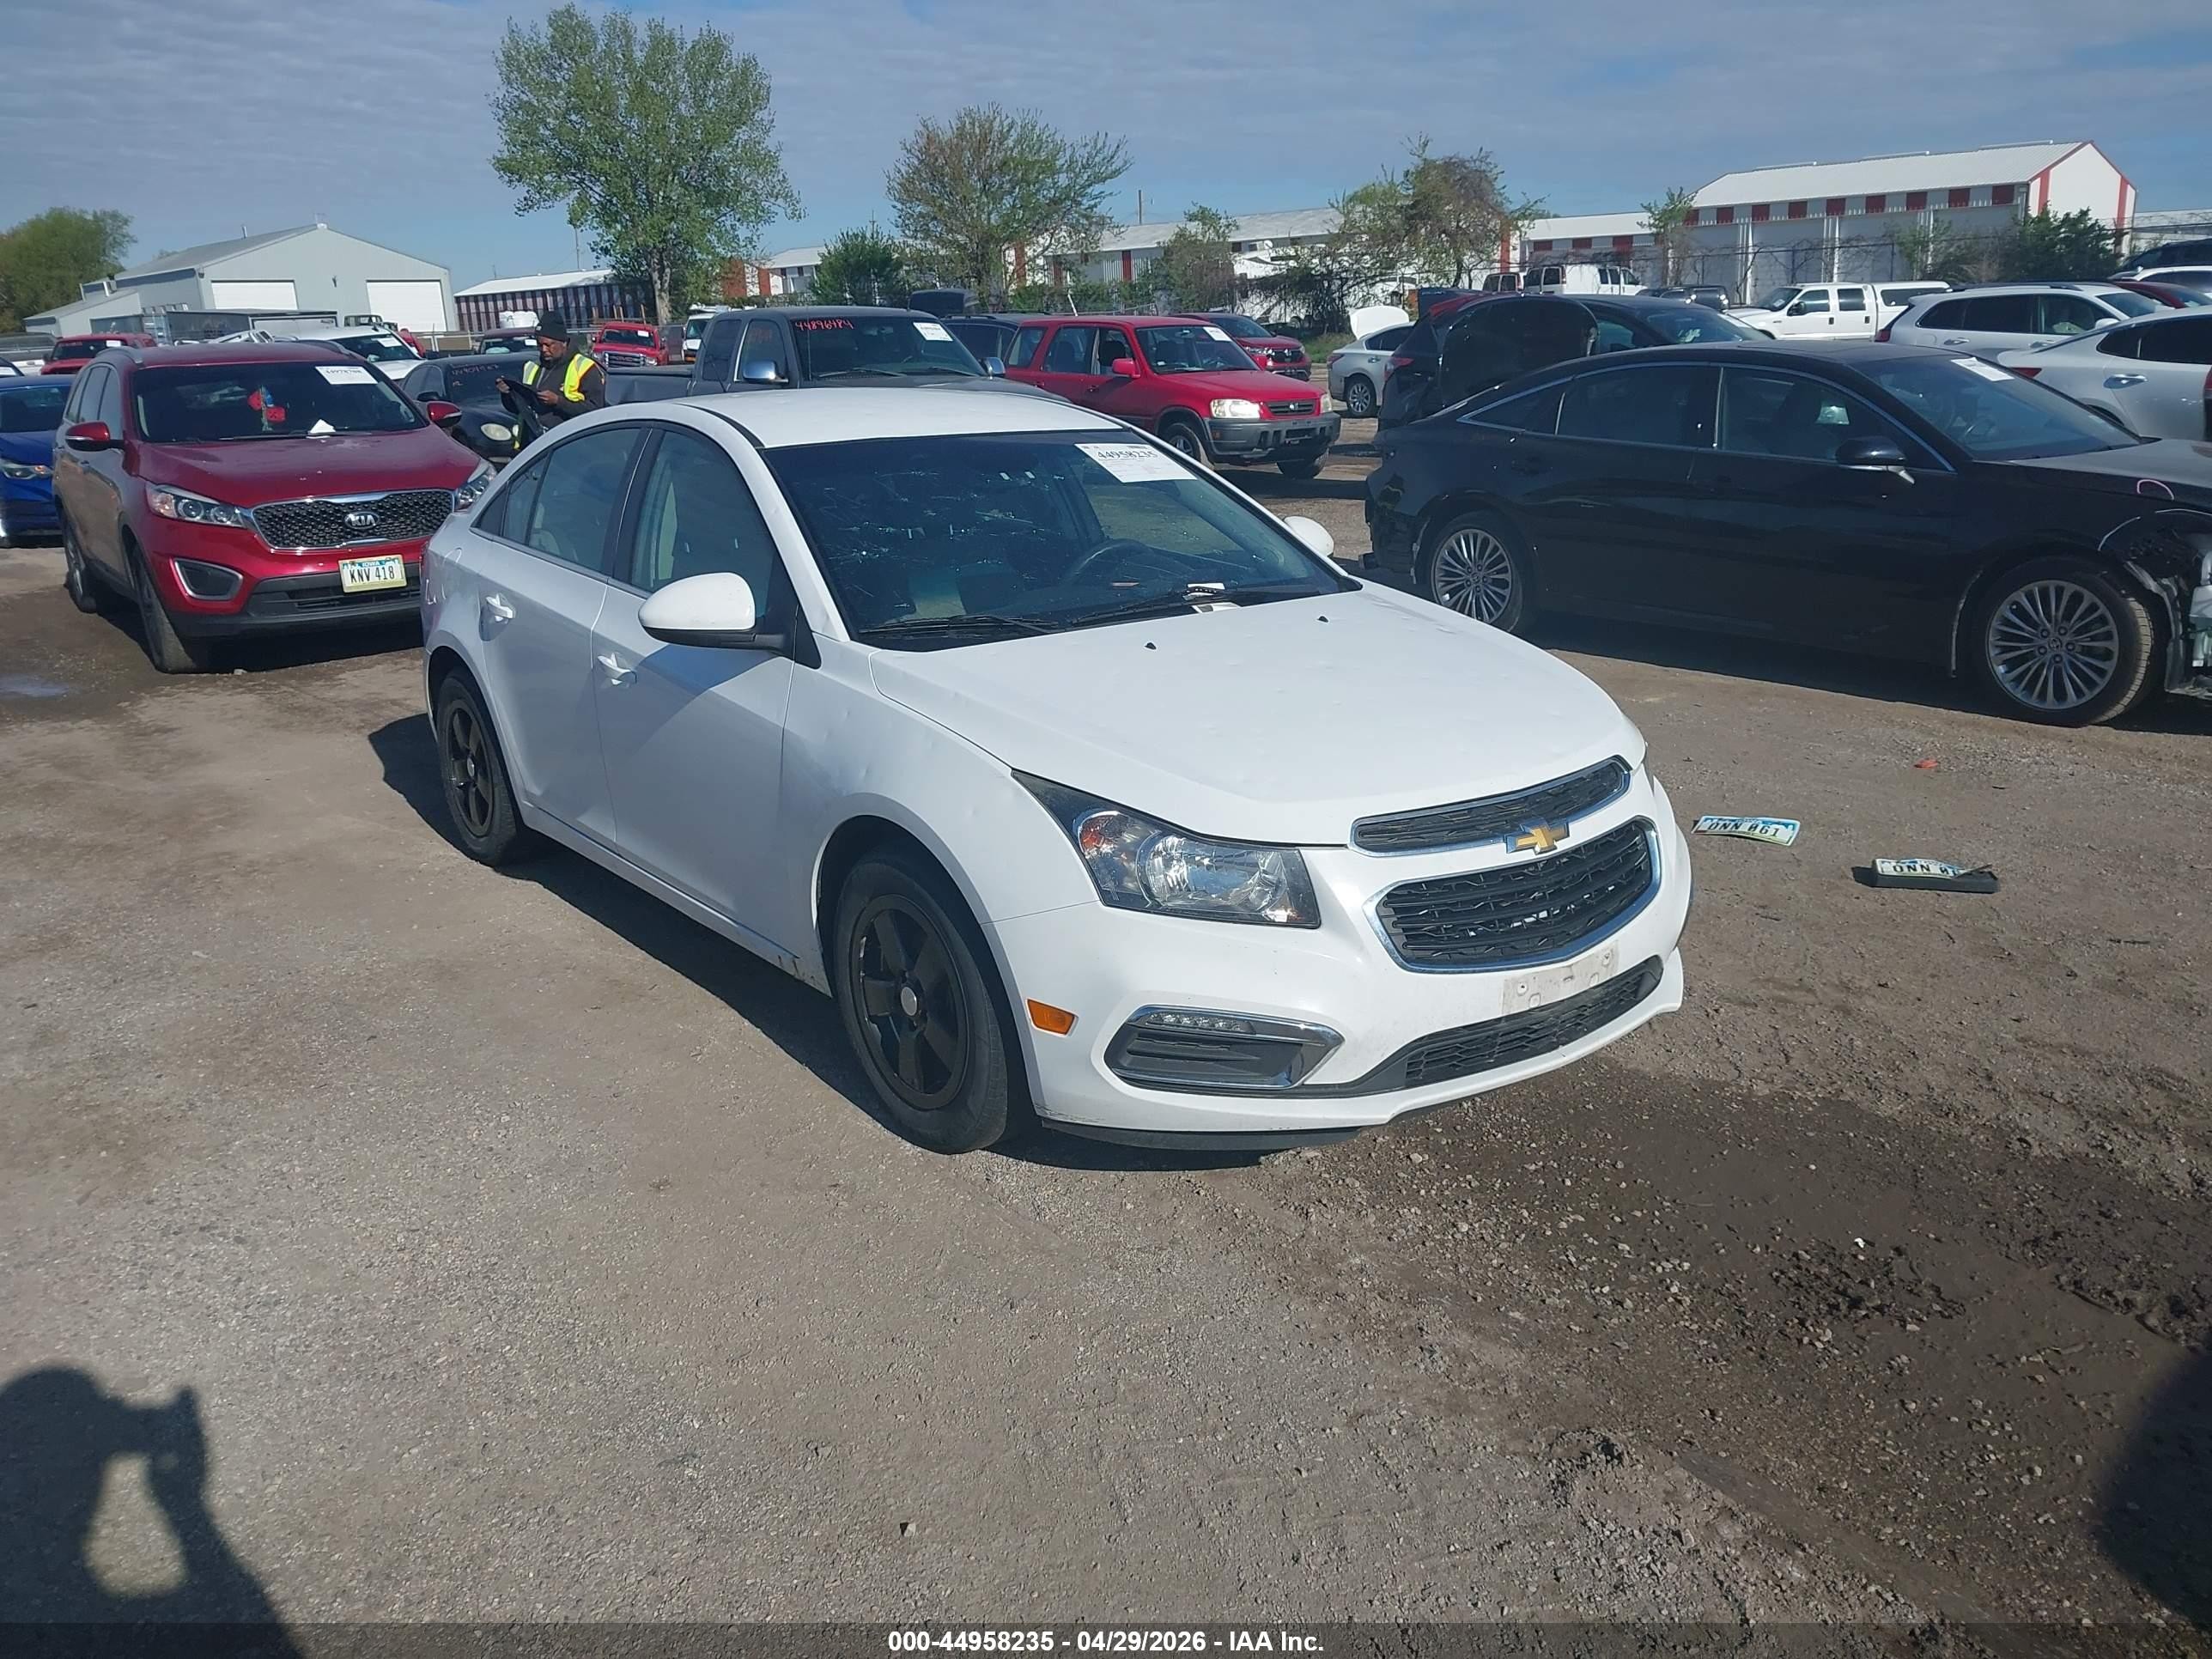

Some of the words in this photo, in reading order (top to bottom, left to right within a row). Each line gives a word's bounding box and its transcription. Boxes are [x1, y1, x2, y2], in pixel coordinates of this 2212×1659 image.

[795, 319, 854, 331] 44896484
[350, 514, 376, 526] KIA
[349, 568, 370, 584] KNV
[375, 565, 395, 580] 418
